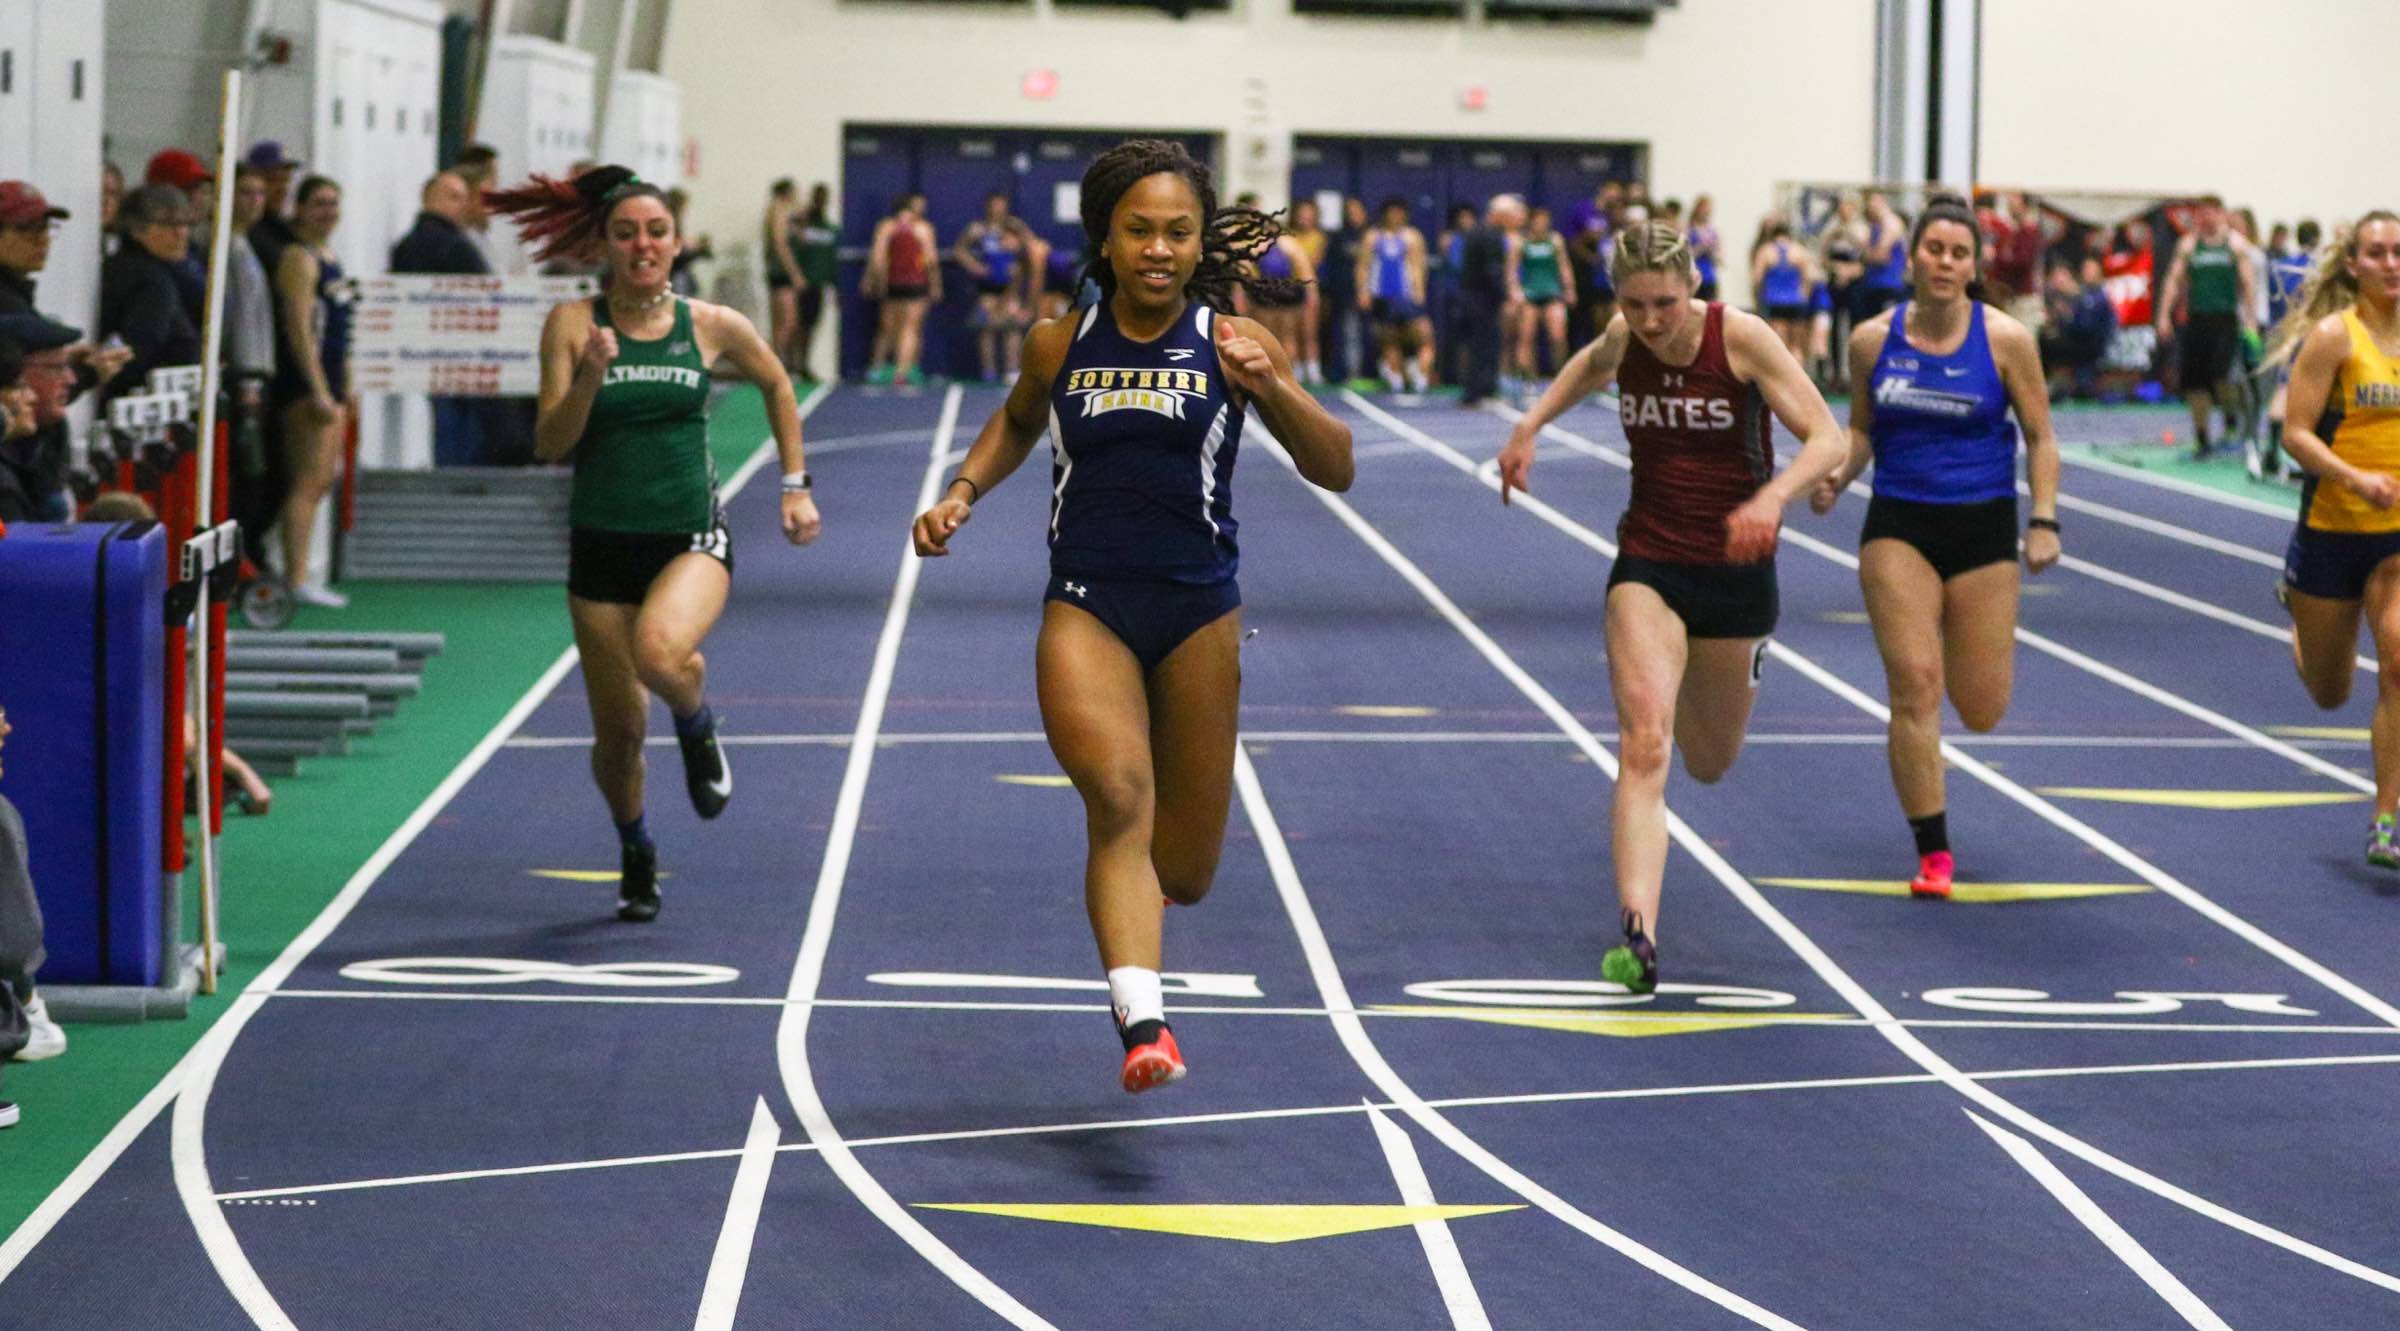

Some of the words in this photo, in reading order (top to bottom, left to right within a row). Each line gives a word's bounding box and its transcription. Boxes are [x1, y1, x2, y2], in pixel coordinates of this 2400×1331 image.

[602, 364, 700, 389] LYMOUTH
[1068, 371, 1208, 396] SOUTHERN
[1101, 390, 1165, 410] MAINE
[1620, 393, 1735, 430] BATES
[339, 957, 740, 986] 8
[1404, 979, 1796, 1008] 6
[1922, 987, 2319, 1016] 5
